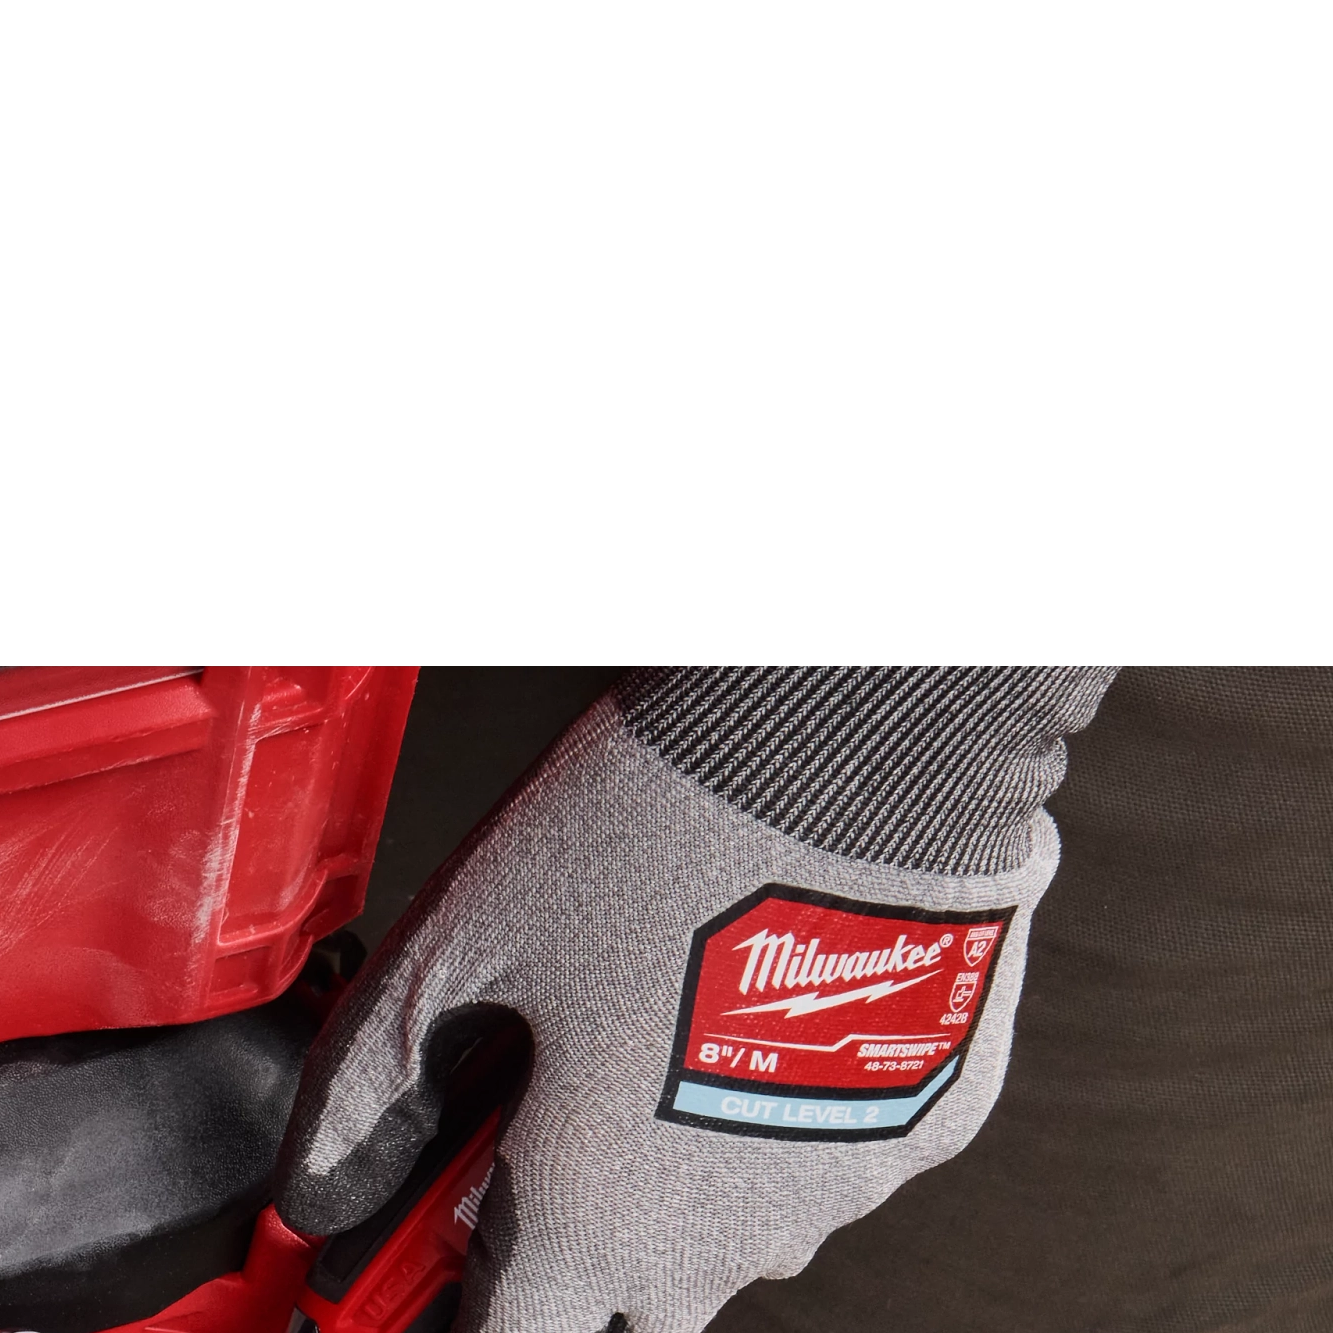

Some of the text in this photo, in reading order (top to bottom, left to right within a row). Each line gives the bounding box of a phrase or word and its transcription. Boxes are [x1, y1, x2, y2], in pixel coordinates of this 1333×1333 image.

[967, 940, 987, 958] A2
[863, 1060, 925, 1071] 48-73-8721
[720, 1095, 880, 1125] CUT LEVEL 2
[362, 1261, 428, 1321] USA
